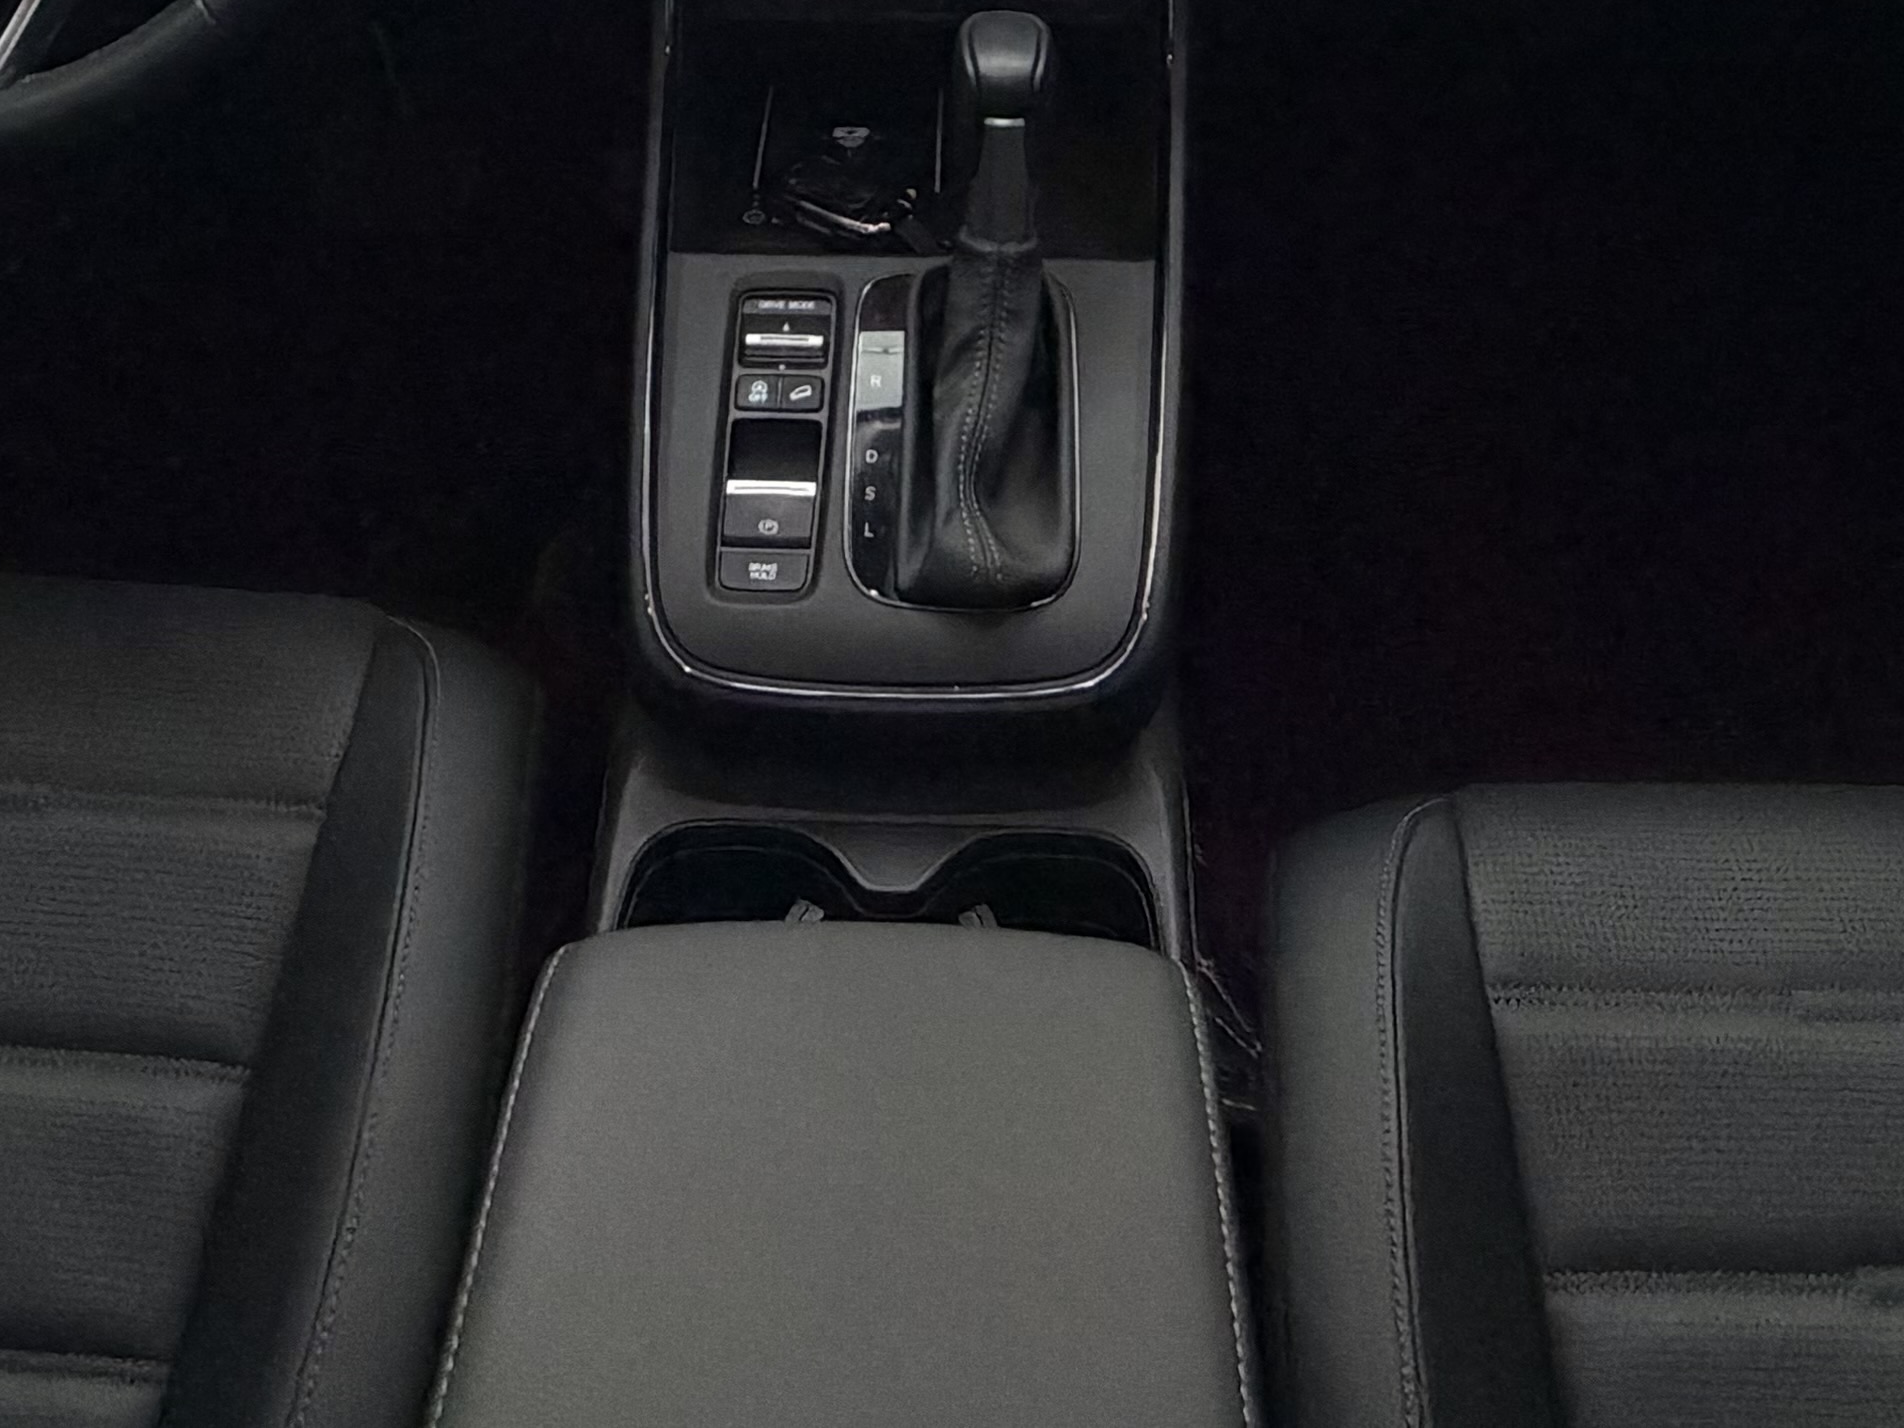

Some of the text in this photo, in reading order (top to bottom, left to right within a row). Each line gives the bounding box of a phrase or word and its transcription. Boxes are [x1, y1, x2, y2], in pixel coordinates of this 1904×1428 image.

[869, 374, 883, 388] R
[865, 448, 879, 464] D
[863, 486, 877, 502] S
[863, 521, 875, 538] L
